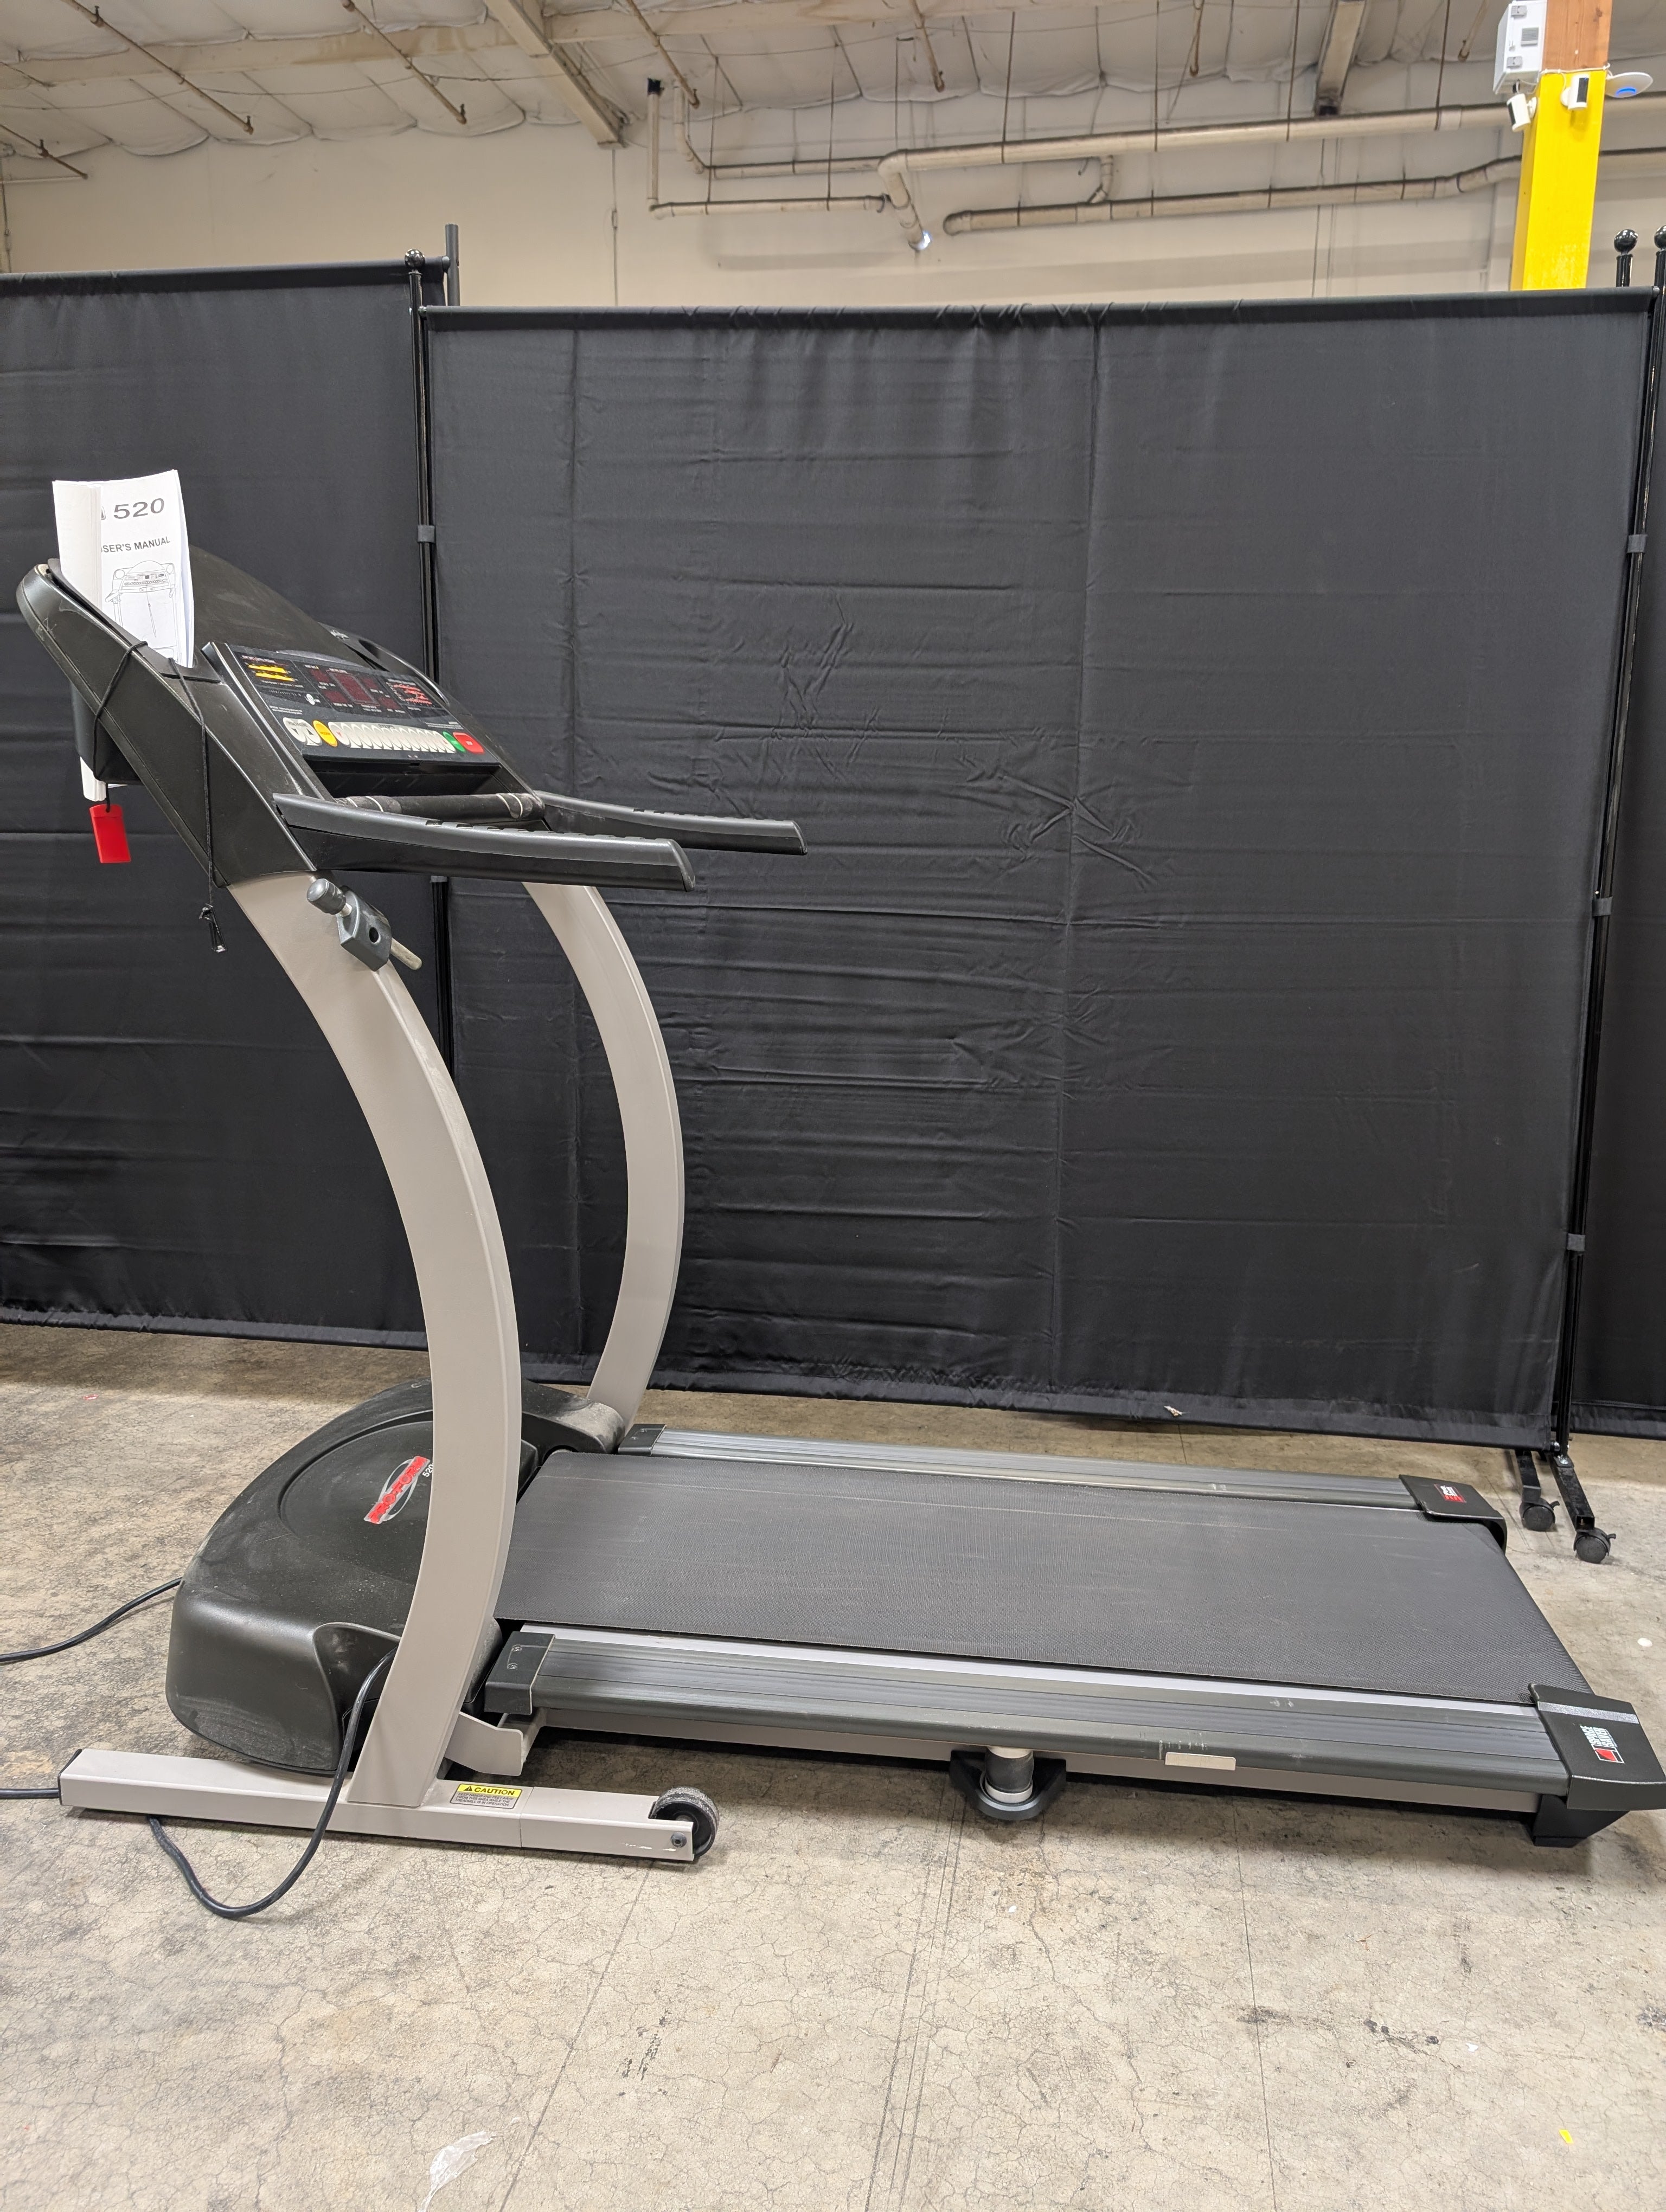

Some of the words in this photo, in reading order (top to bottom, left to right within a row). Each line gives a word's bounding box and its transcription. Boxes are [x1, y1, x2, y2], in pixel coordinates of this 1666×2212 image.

[113, 498, 165, 519] 520
[100, 543, 132, 553] SER'S
[133, 536, 171, 550] MANUAL
[1579, 1725, 1603, 1745] SPACE
[1592, 1727, 1615, 1747] SAVER
[474, 1787, 515, 1796] CAUTION
